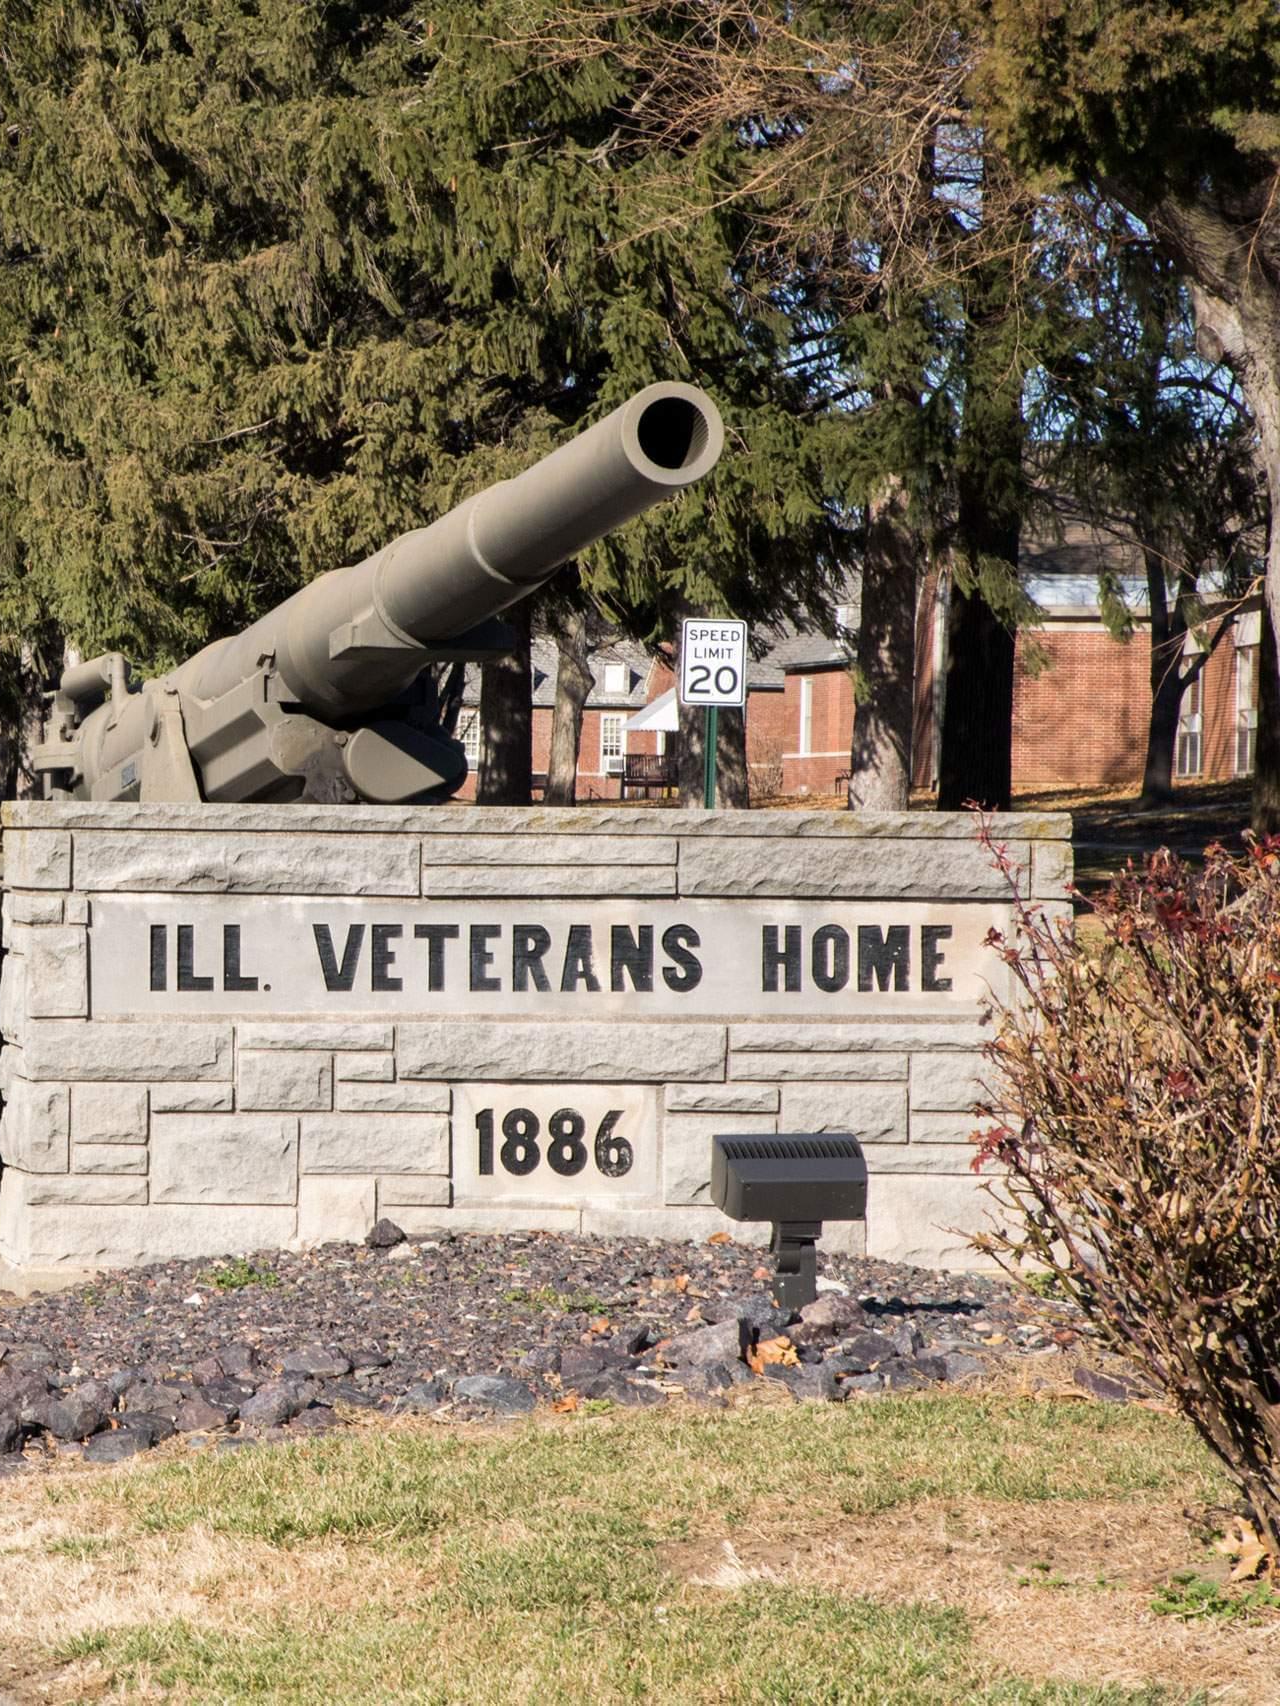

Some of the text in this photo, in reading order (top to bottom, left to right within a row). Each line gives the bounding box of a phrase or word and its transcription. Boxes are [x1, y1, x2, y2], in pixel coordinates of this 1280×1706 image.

[689, 629, 740, 641] SPEED
[694, 647, 734, 659] LIMIT
[688, 665, 738, 694] 20
[150, 923, 954, 993] ILL. VETERANS HOME
[475, 1107, 634, 1178] 1886
